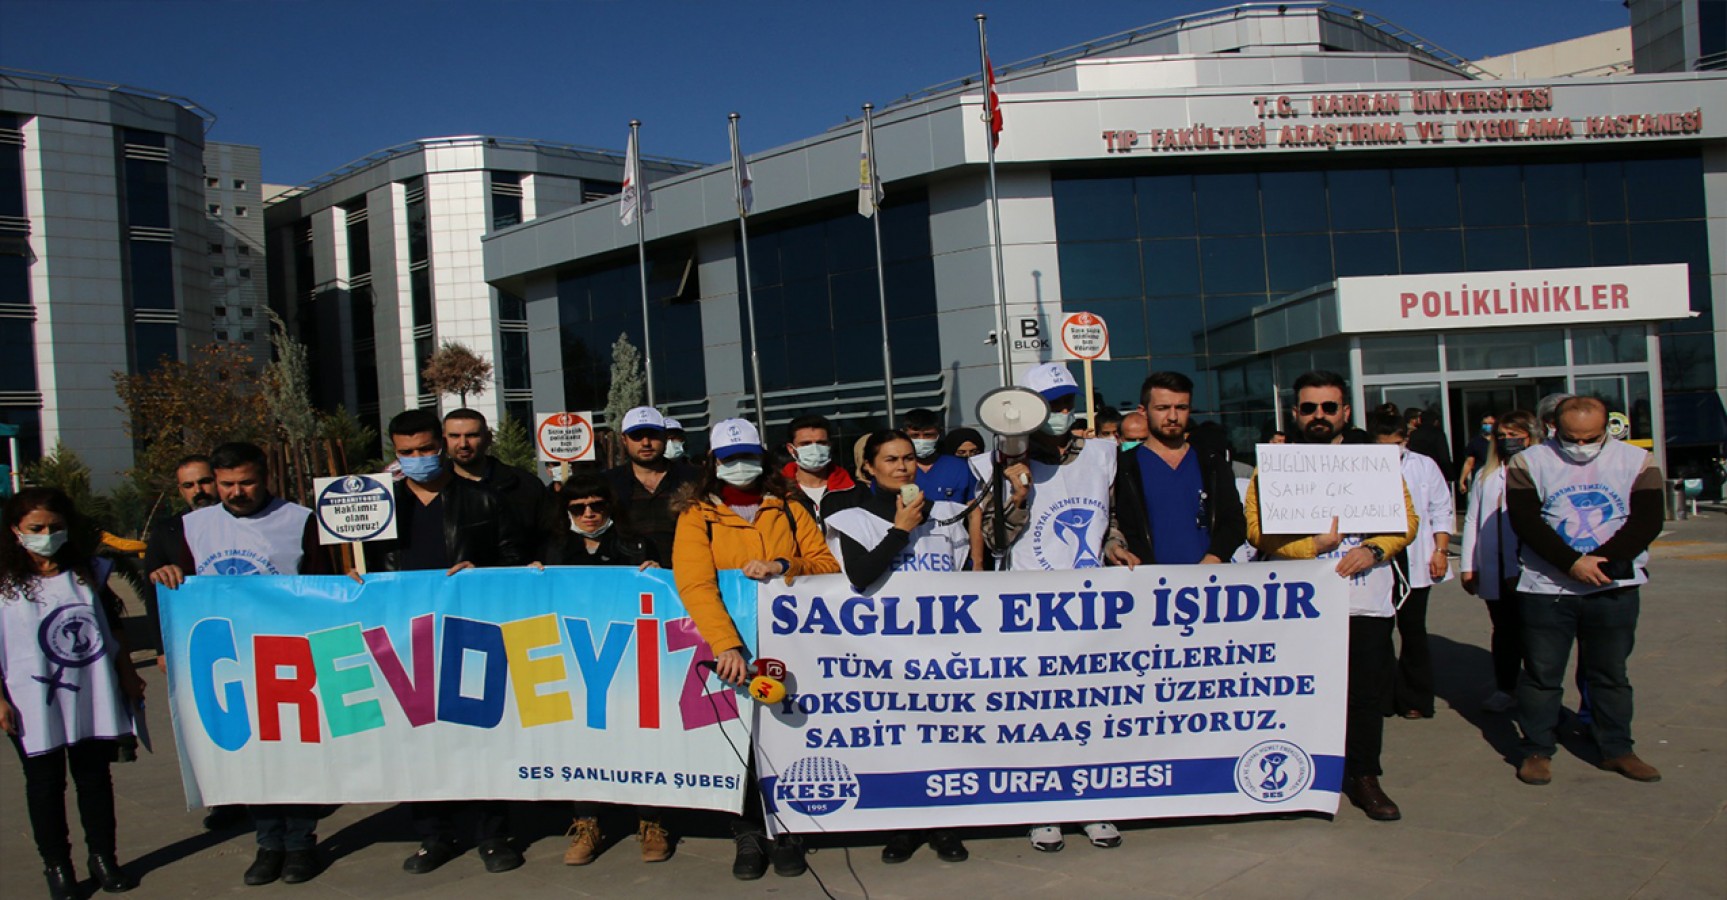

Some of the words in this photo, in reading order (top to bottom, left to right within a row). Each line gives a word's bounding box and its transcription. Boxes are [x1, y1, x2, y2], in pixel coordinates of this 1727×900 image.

[1254, 95, 1298, 119] T.C.
[1312, 92, 1400, 117] HARRAN
[1411, 86, 1552, 114] ÜNİVERSİTESİ
[1103, 129, 1138, 153] TIP
[1151, 121, 1267, 152] FAKÜLTESİ
[1279, 121, 1407, 150] ARAŞTIRMA
[1417, 120, 1445, 143] VE
[1456, 116, 1574, 142] UYGULAMA
[1584, 106, 1702, 139] HASTANESİ
[1399, 281, 1631, 318] POLİKLİNİKLER
[1014, 340, 1049, 350] BLOK
[1021, 319, 1040, 338] B
[1320, 454, 1391, 473] HAKKINA
[1265, 502, 1304, 521] YARIN
[999, 579, 1135, 633] EKİP
[1152, 572, 1320, 637] İŞİDİR
[189, 592, 740, 752] GREVDEYİZ
[817, 653, 893, 679] TÜM
[904, 652, 1028, 680] SAĞLIK
[1037, 639, 1276, 677] EMEKÇİLERİNE
[781, 691, 976, 715] YOKSULLUK
[986, 683, 1145, 713] SINIRININ
[1155, 672, 1315, 703] ÜZERİNDE
[805, 720, 906, 749] SABİT
[917, 724, 986, 745] TEK
[997, 720, 1091, 746] MAAŞ
[1103, 709, 1287, 739] İSTİYORUZ.
[518, 766, 554, 779] SES
[561, 766, 667, 785] ŞANLIURFA
[674, 773, 740, 790] ŞUBESİ
[777, 783, 857, 800] KESK
[926, 773, 979, 797] SES
[989, 771, 1062, 793] URFA
[1071, 764, 1172, 796] ŞUBESİ
